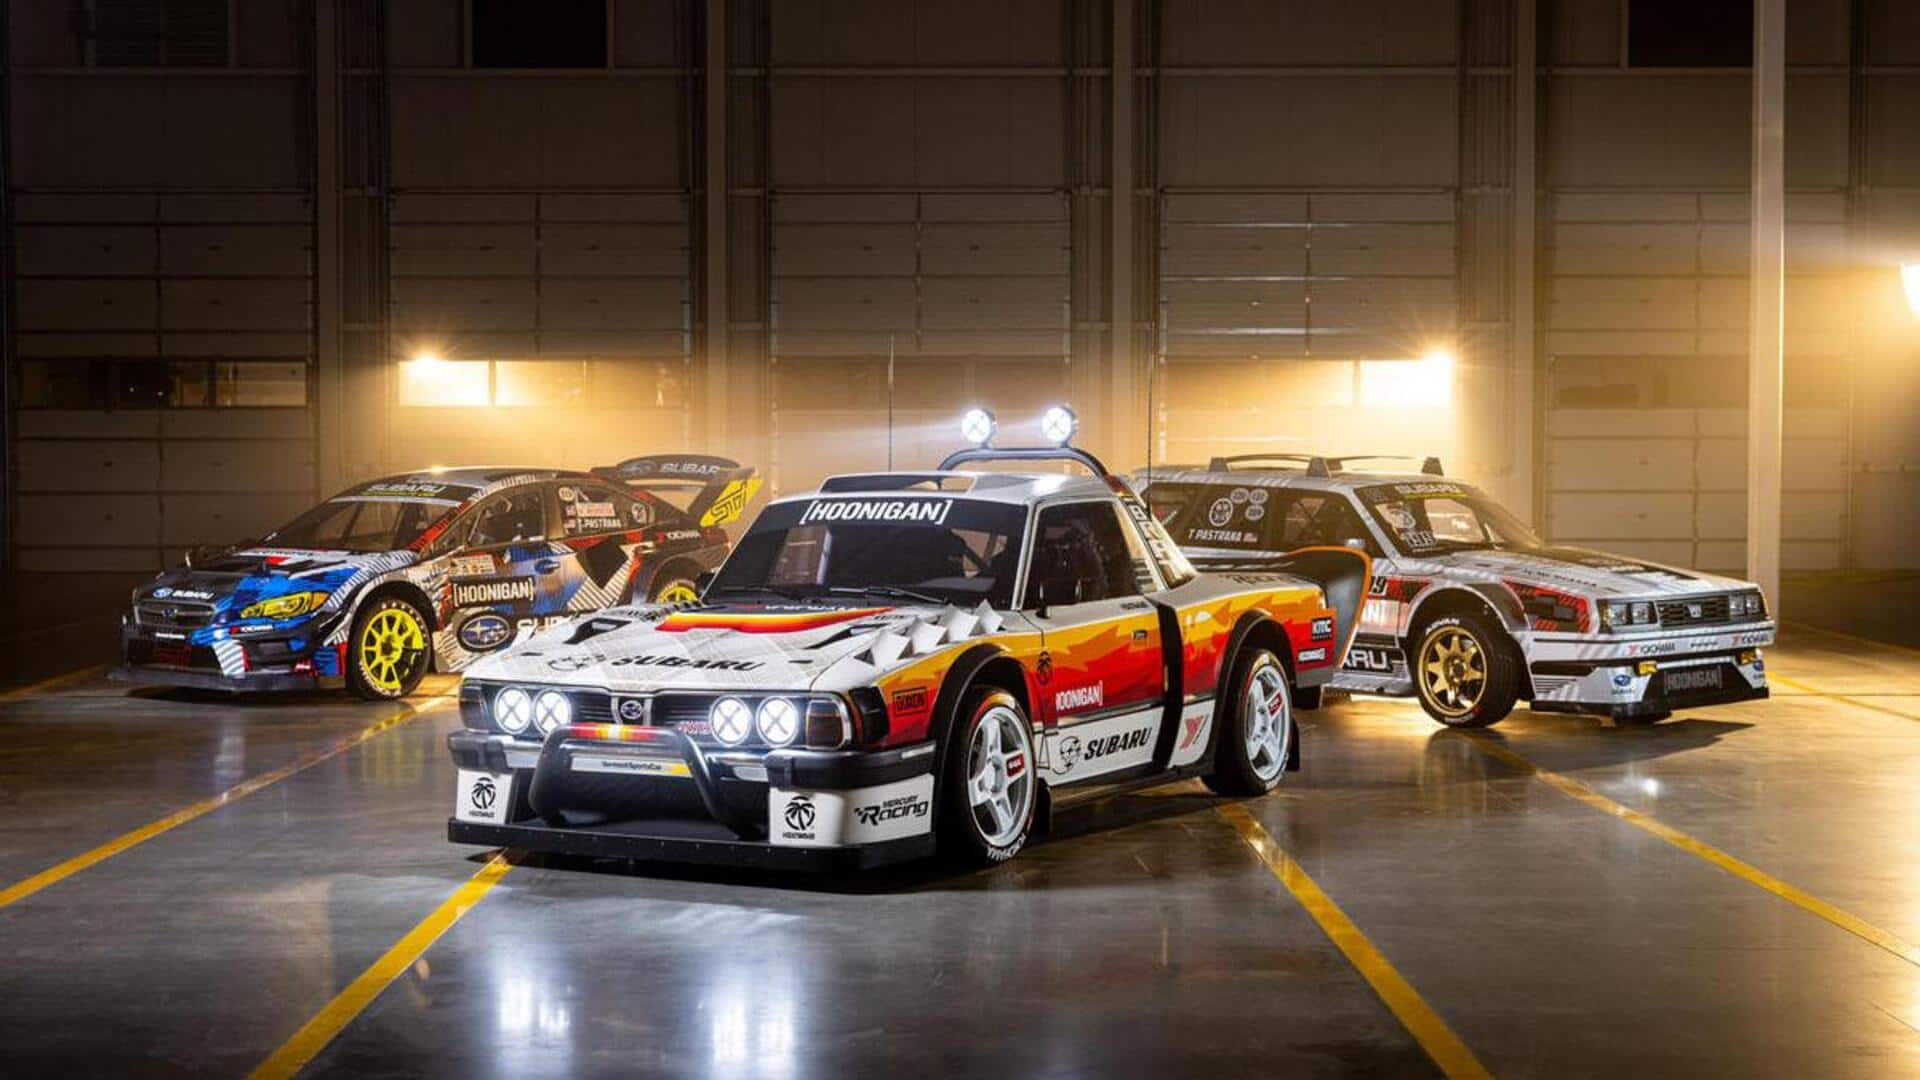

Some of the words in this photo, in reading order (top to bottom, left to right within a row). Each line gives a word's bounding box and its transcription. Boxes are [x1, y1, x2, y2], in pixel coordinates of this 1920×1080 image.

[798, 500, 954, 525] [HOONIGAN]
[452, 577, 535, 607] [HOONIGAN]
[611, 655, 766, 672] SUBARU
[1084, 728, 1152, 762] SUBARU
[859, 800, 929, 827] Racing
